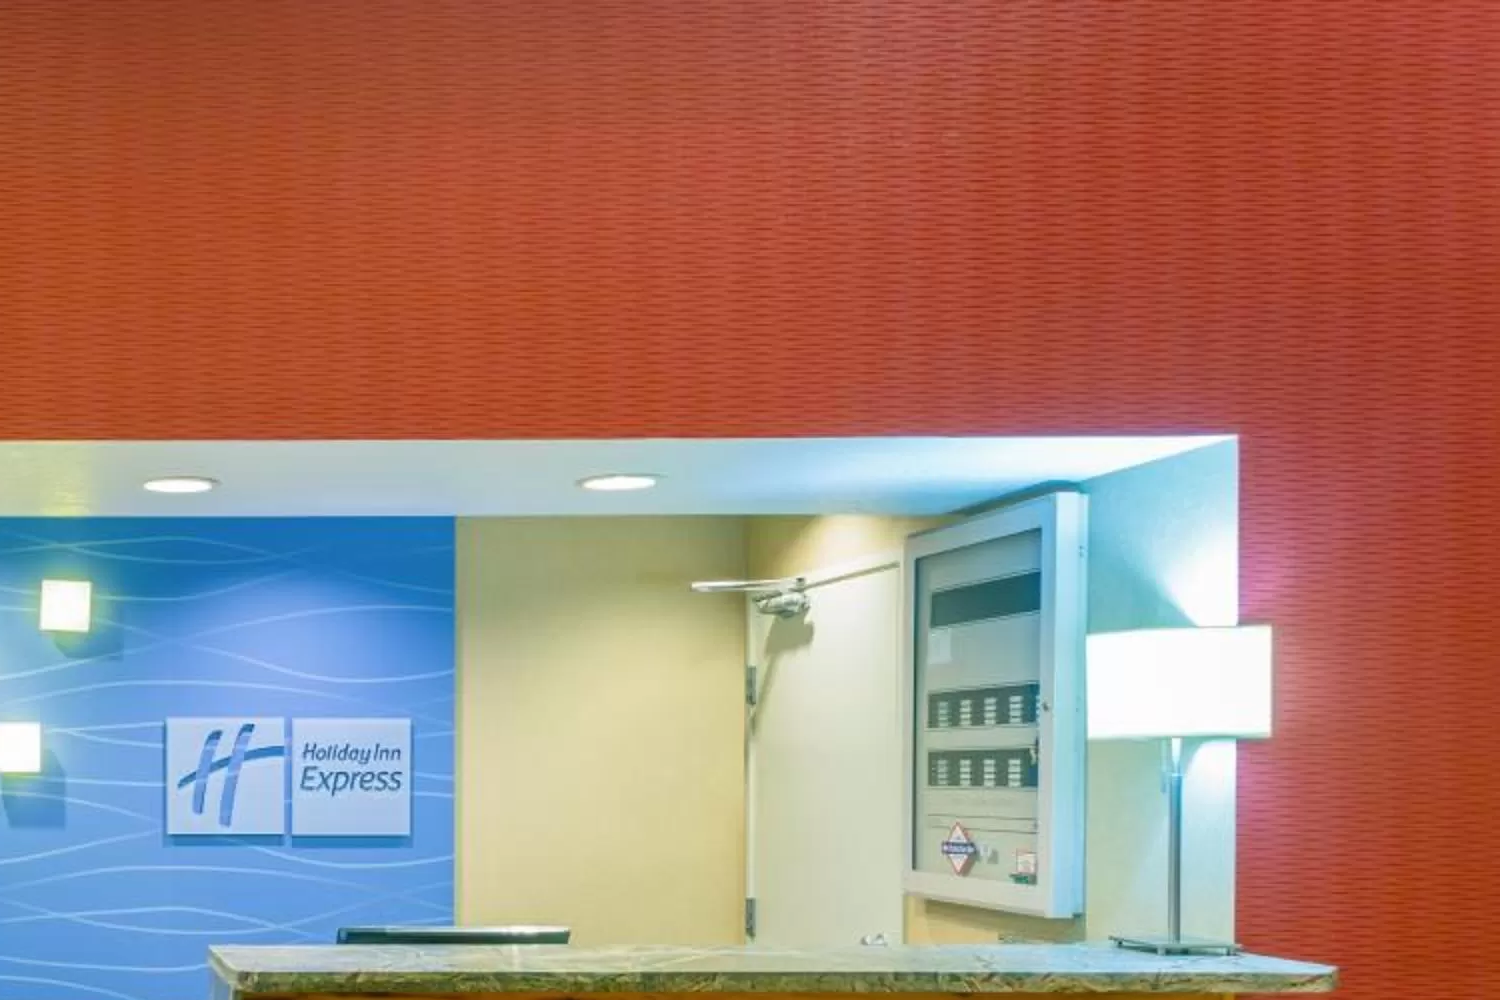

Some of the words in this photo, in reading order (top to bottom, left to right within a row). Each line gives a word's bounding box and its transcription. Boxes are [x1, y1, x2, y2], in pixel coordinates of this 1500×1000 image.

[301, 742, 371, 764] Holiday
[373, 743, 401, 761] Inn
[299, 765, 402, 797] Express
